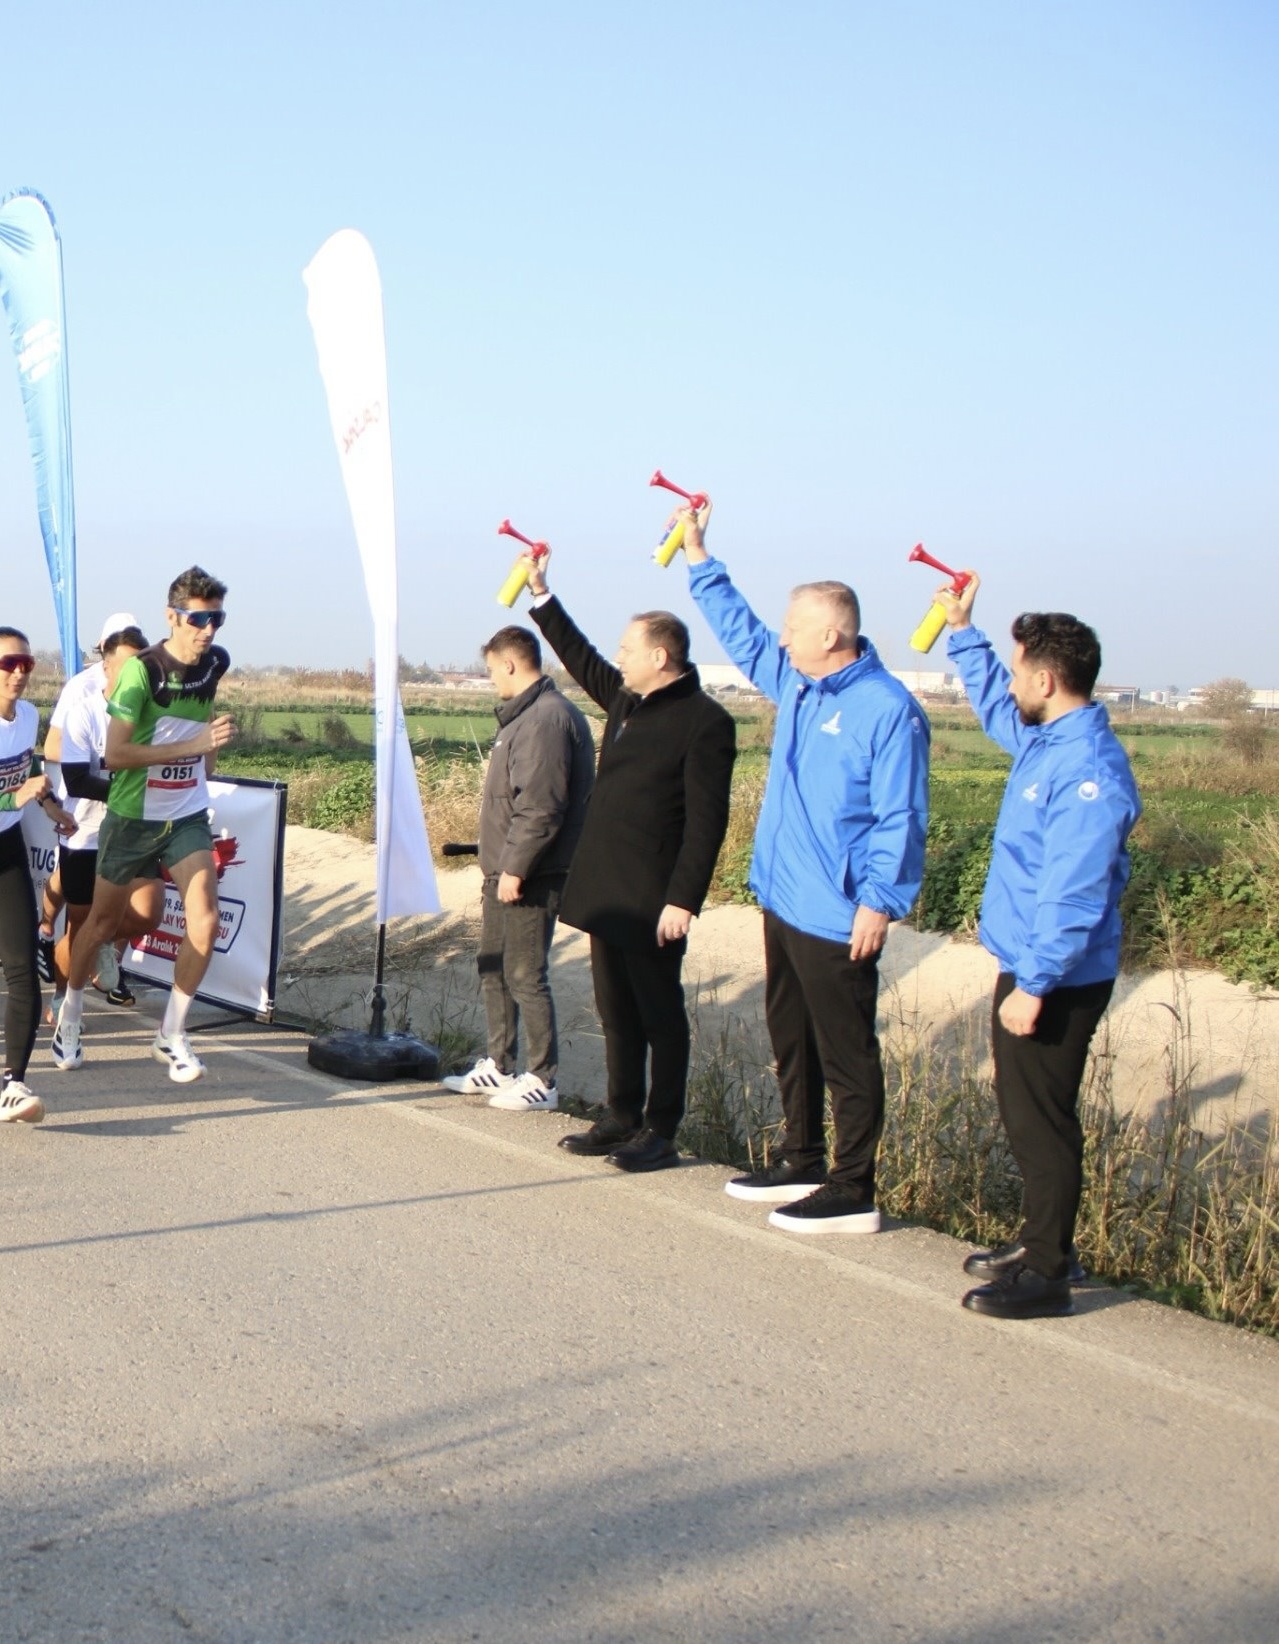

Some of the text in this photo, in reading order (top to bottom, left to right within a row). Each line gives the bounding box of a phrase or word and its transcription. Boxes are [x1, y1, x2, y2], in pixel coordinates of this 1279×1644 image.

[161, 765, 193, 780] 0151
[30, 846, 55, 873] TUG
[219, 909, 234, 923] MEN
[151, 937, 174, 954] Aralık
